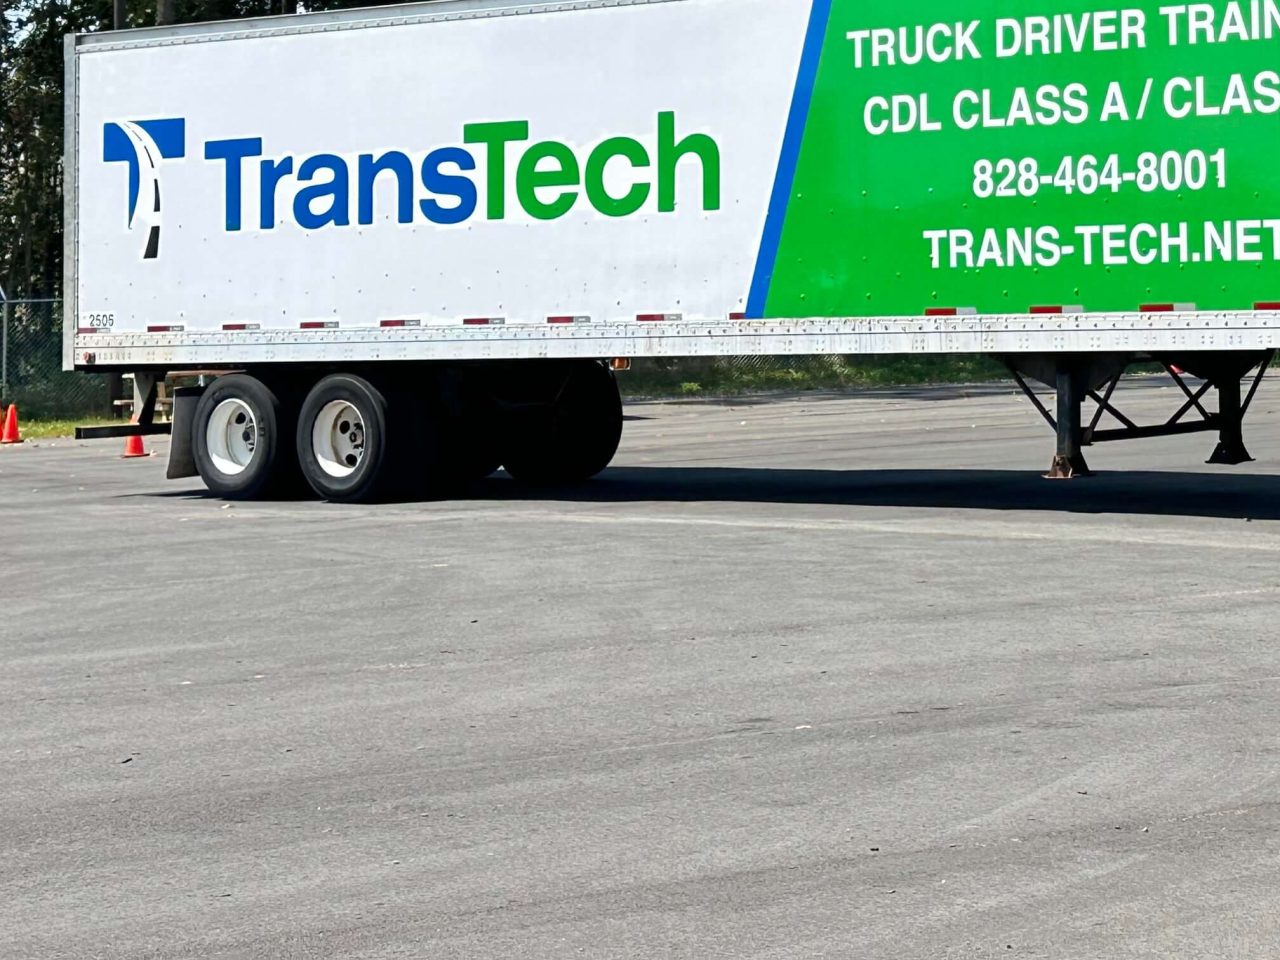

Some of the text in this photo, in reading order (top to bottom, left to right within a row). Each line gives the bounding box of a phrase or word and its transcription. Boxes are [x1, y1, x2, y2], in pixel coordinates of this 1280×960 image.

[846, 19, 982, 68] TRUCK
[995, 8, 1146, 58] DRIVER
[863, 92, 942, 135] CDL
[952, 82, 1089, 130] CLASS
[1099, 81, 1130, 122] A
[204, 111, 720, 231] TransTech
[972, 148, 1228, 198] 828-464-8001
